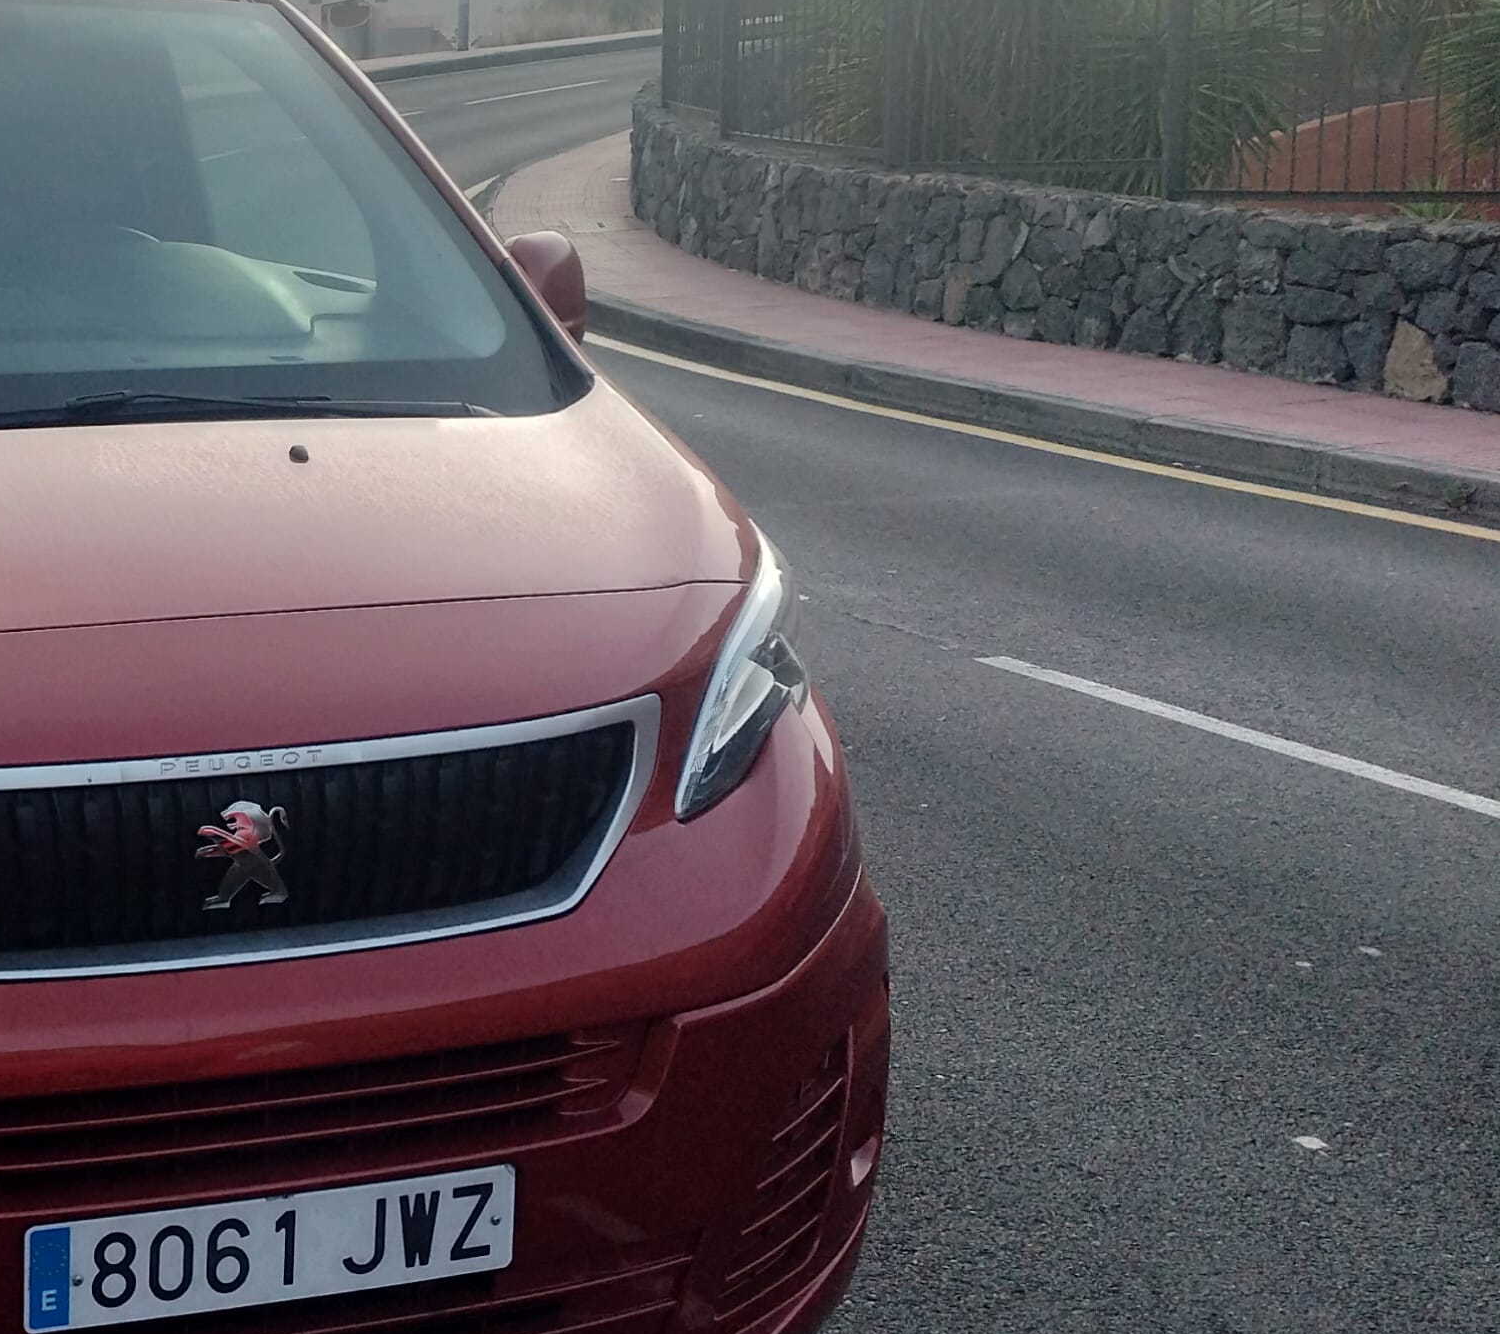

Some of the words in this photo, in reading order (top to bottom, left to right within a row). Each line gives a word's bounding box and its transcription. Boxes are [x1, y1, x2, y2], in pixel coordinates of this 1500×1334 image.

[160, 749, 322, 776] PEUGEOT
[91, 1209, 296, 1309] 8061
[342, 1182, 494, 1275] JWZ
[40, 1289, 58, 1312] E
